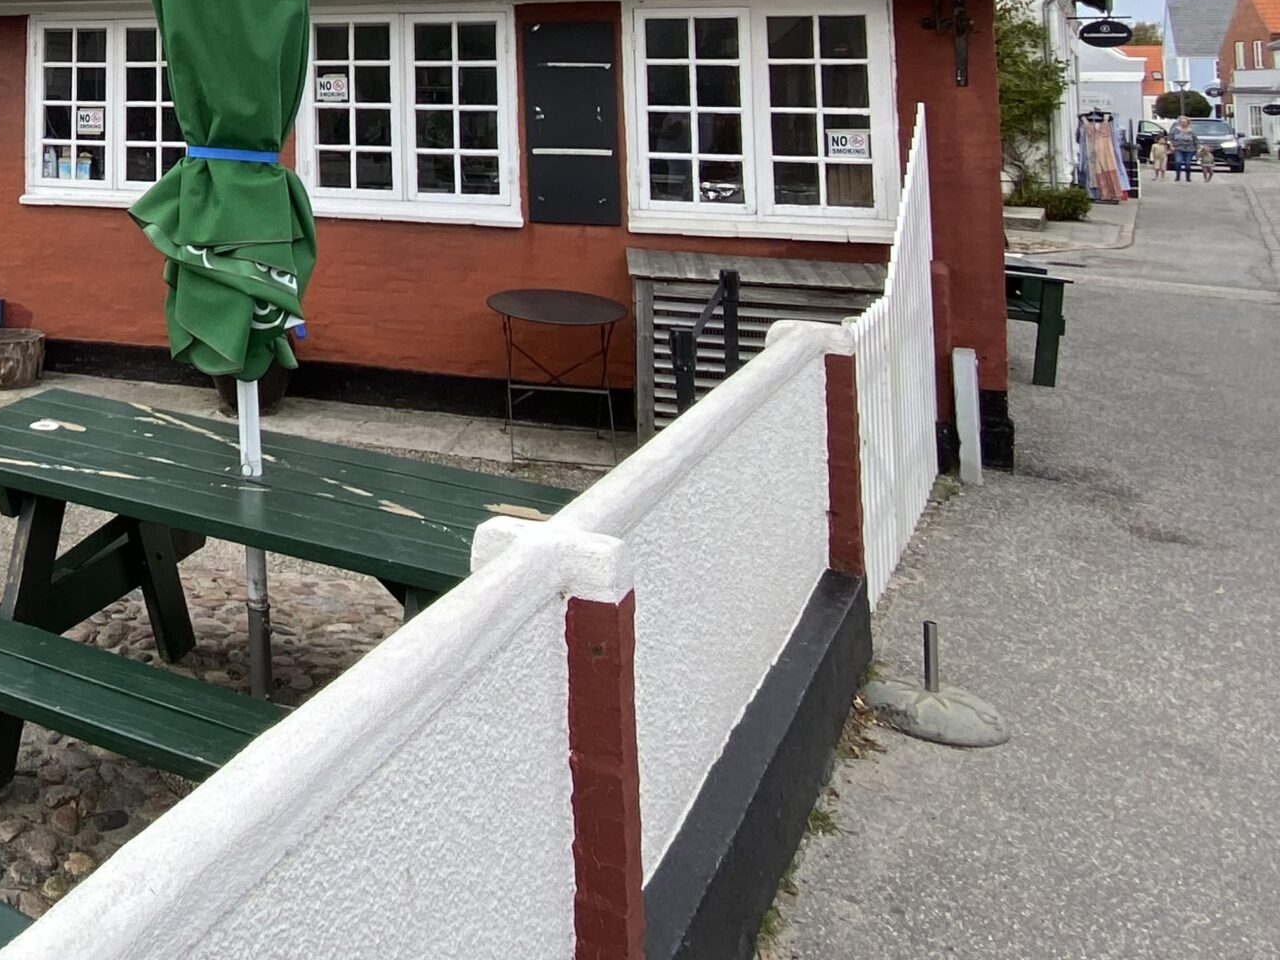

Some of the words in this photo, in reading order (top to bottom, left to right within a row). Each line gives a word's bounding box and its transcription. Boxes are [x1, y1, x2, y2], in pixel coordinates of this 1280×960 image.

[319, 80, 332, 91] NO
[79, 113, 91, 123] NO
[831, 135, 848, 147] NO
